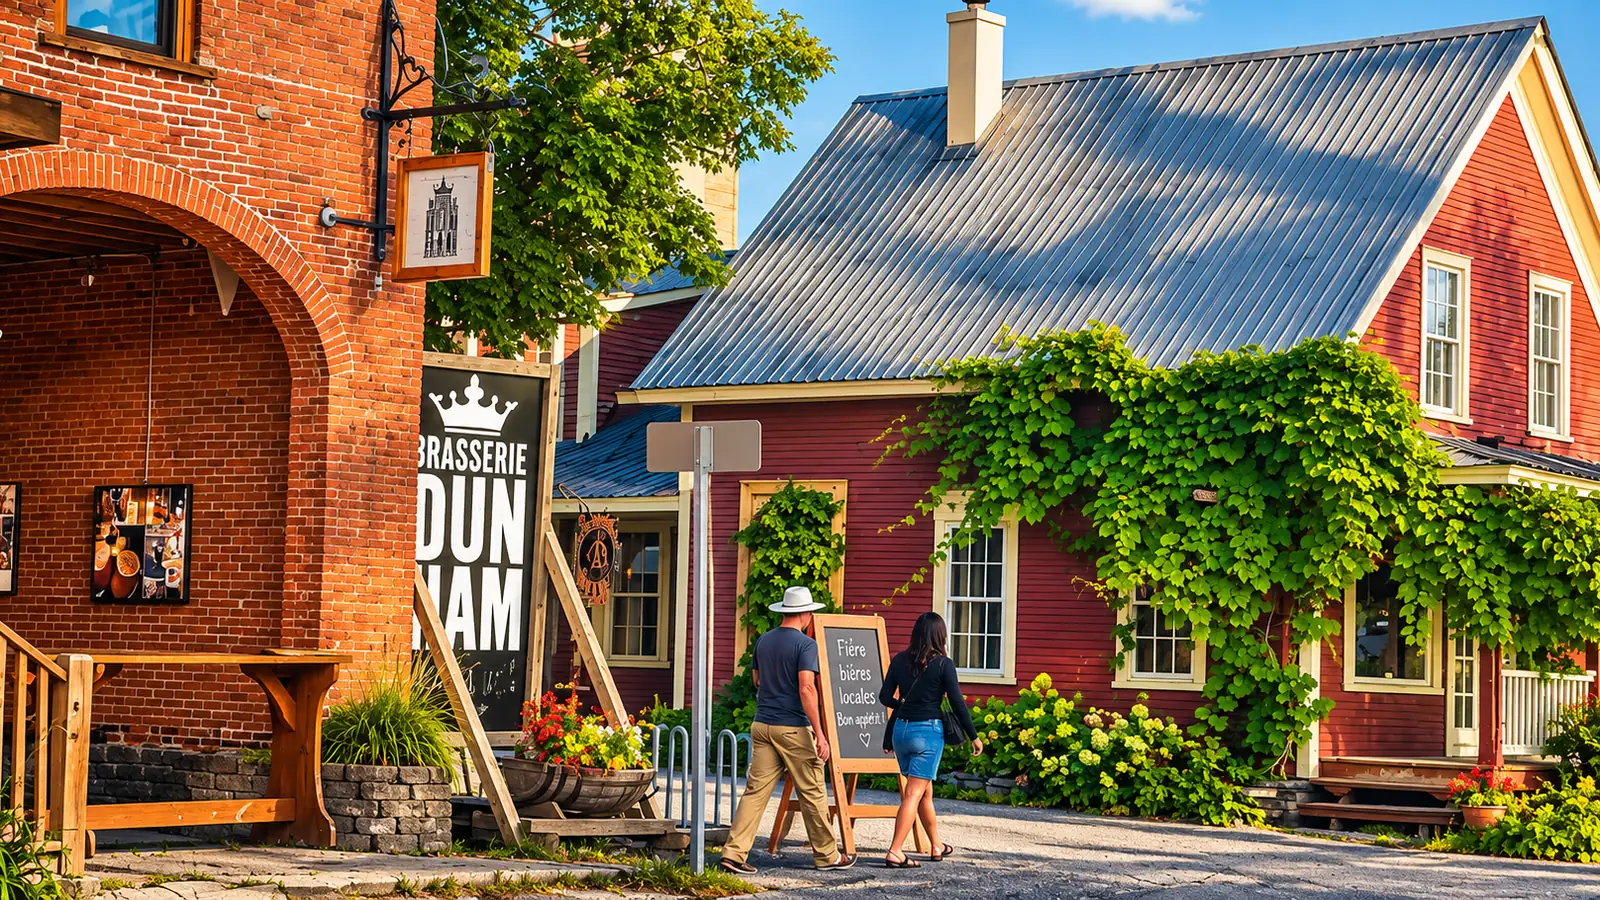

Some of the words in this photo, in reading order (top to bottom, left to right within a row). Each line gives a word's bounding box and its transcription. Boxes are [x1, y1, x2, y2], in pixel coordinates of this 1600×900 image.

[418, 435, 527, 475] BRASSERIE
[415, 473, 526, 564] DUN
[839, 686, 876, 705] locales
[836, 711, 854, 727] Bon
